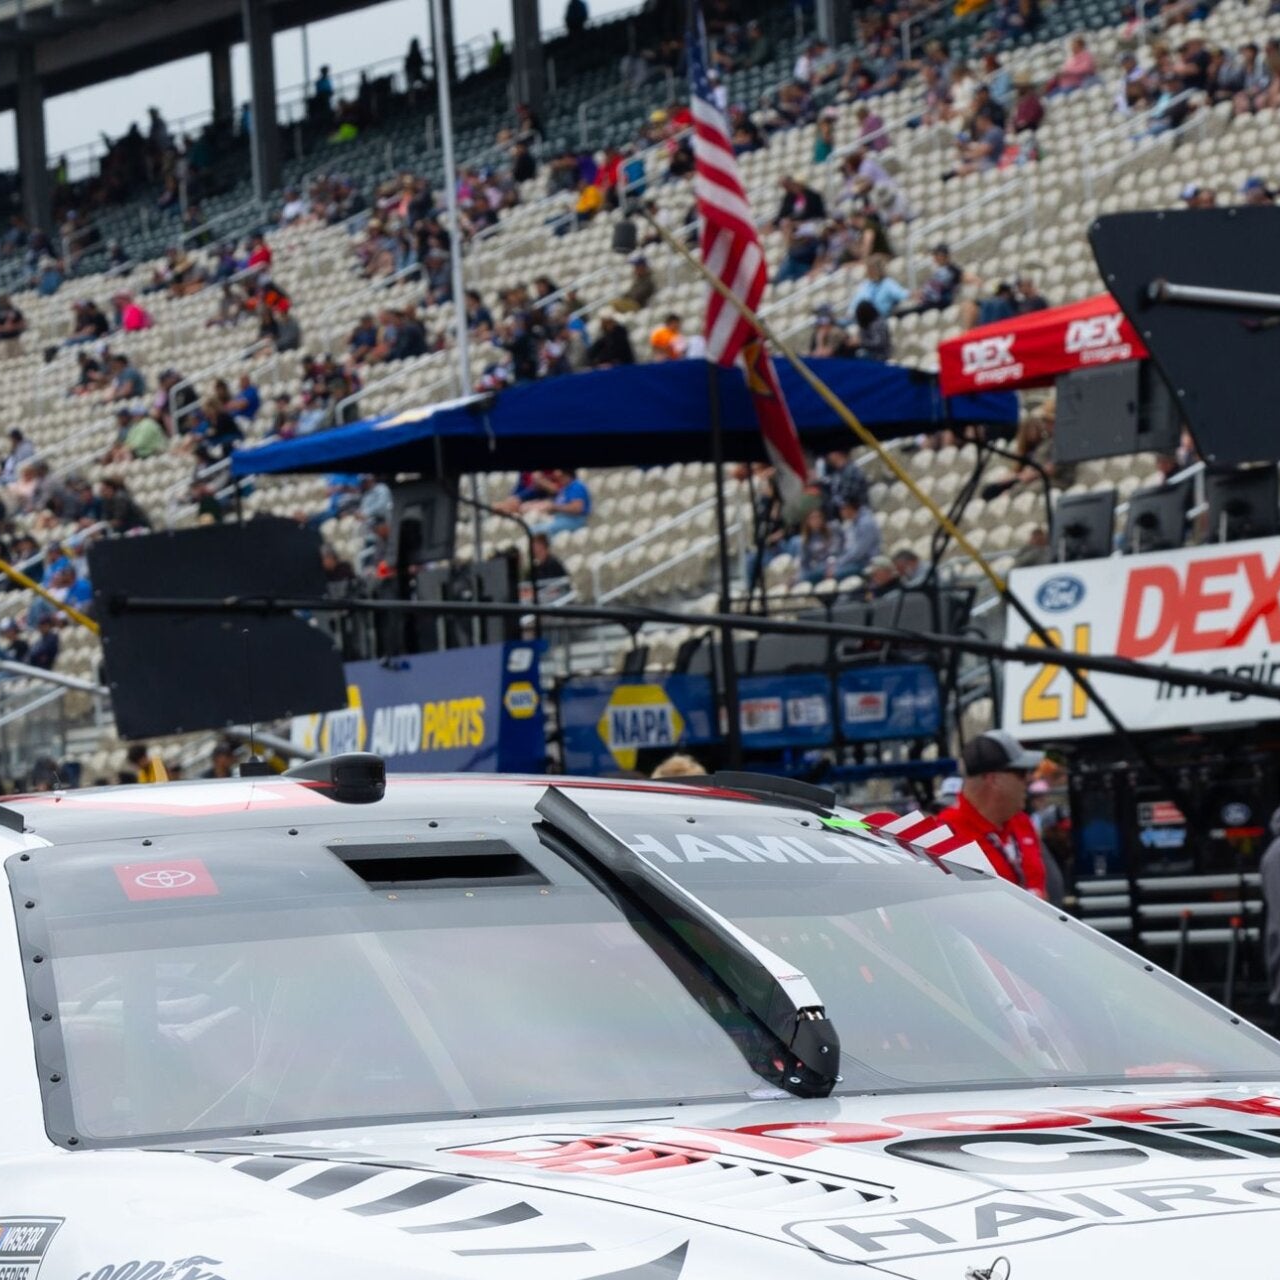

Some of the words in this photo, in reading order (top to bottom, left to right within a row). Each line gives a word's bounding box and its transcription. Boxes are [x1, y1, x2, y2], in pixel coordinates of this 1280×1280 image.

[961, 334, 1016, 375] DEX
[1065, 313, 1122, 354] DEX
[372, 703, 422, 756] AUTO
[422, 696, 486, 751] PARTS
[612, 702, 671, 749] NAPA
